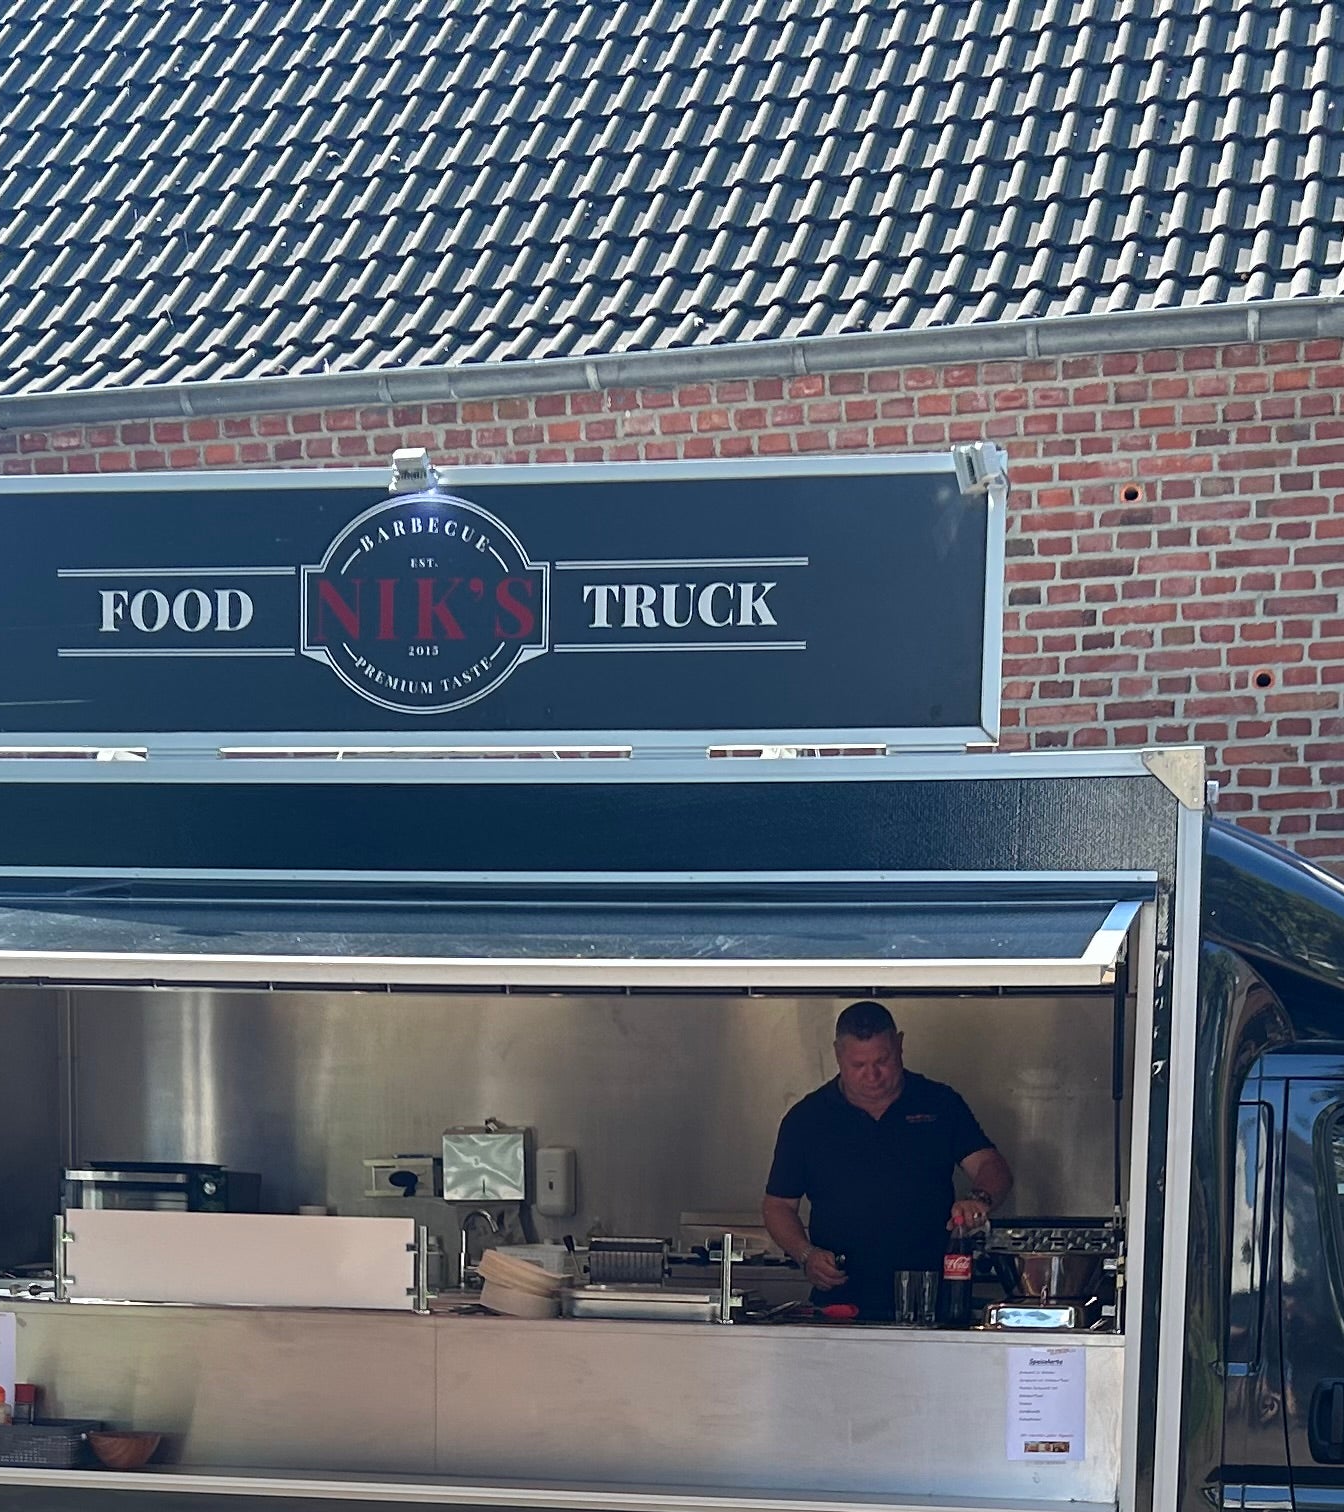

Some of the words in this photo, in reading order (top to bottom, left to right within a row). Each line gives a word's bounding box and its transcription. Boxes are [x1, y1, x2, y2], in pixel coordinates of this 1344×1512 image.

[359, 516, 490, 553] BARBECUE
[409, 557, 439, 569] EST.
[98, 588, 254, 634] FOOD
[312, 577, 536, 641] NIK'S
[583, 580, 778, 630] TRUCK
[354, 656, 434, 695] PREMIUM
[439, 656, 493, 692] TASTE
